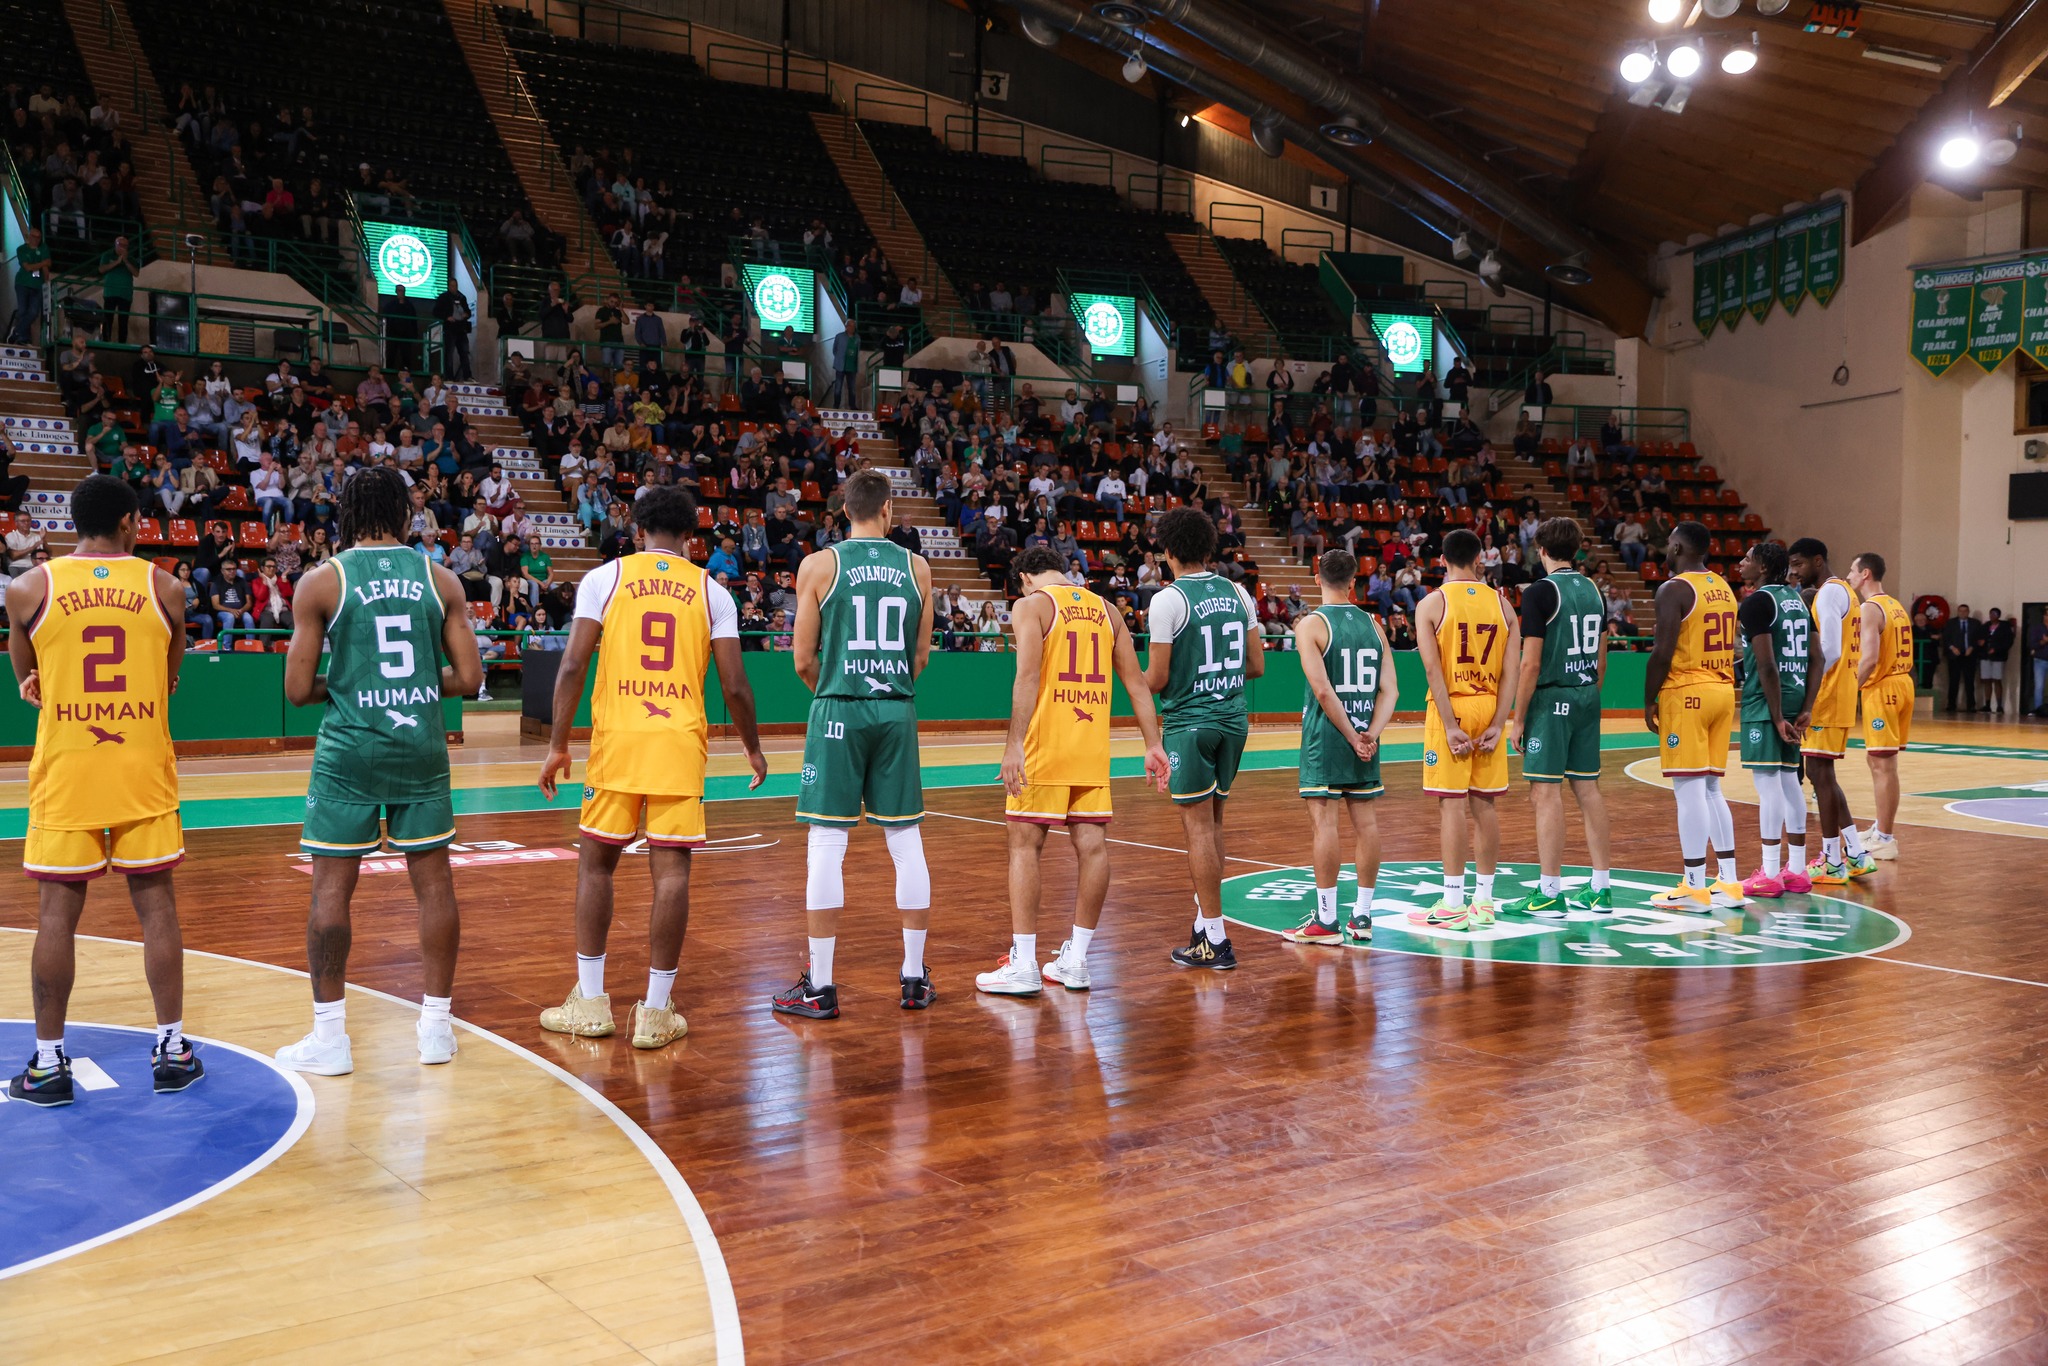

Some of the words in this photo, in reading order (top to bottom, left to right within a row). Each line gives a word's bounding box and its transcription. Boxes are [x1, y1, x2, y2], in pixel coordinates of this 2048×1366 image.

[989, 75, 1000, 96] 3
[1320, 191, 1327, 207] 1
[387, 245, 425, 271] CSP
[1935, 272, 1974, 285] LIMOGES
[1983, 265, 2025, 280] LIMOGES
[762, 284, 794, 307] CSP
[1917, 316, 1966, 328] CHAMPION
[1979, 311, 2003, 322] COUPE
[1935, 330, 1948, 339] DE
[1986, 323, 1997, 334] DE
[1922, 341, 1957, 351] FRANCE
[471, 397, 499, 405] Limoges
[16, 429, 27, 438] de
[31, 430, 70, 441] Limoges
[506, 460, 536, 469] Limoges
[24, 505, 47, 514] Ville
[50, 506, 62, 514] de
[533, 526, 542, 534] de
[544, 527, 575, 535] Limoges
[930, 539, 956, 547] Limoges
[95, 568, 107, 576] CSP
[657, 561, 669, 570] CSP
[846, 565, 907, 588] JOVANOVIC
[354, 579, 425, 605] LEWIS
[625, 578, 697, 605] TANNER
[1703, 589, 1731, 604] WARE
[56, 587, 148, 616] FRANKLIN
[1193, 597, 1239, 620] COURSET
[847, 595, 908, 651] 10
[1703, 611, 1736, 652] 20
[640, 611, 676, 671] 9
[1457, 622, 1498, 665] 17
[1567, 614, 1601, 656] 18
[1782, 618, 1808, 657] 32
[1895, 625, 1910, 658] 15
[375, 614, 415, 679] 5
[1198, 621, 1244, 674] 13
[82, 625, 126, 692] 2
[1058, 631, 1105, 683] 11
[1701, 658, 1733, 670] HUA
[844, 659, 909, 675] HUMAN
[1335, 648, 1378, 692] 16
[618, 679, 693, 700] HUMAN
[1193, 674, 1244, 693] HUMAN
[358, 685, 439, 708] HUMAN
[1053, 689, 1108, 704] HUMAN
[1684, 697, 1701, 710] 20
[1886, 694, 1897, 705] 15
[56, 701, 155, 721] HUMAN
[1553, 702, 1570, 716] 18
[824, 720, 844, 740] 10
[1872, 720, 1883, 728] CSP
[1528, 740, 1539, 750] CSP
[1426, 752, 1437, 764] CSP
[801, 767, 816, 779] CSP
[1245, 878, 1318, 901] 1929
[1563, 911, 1852, 958] LIMOGES
